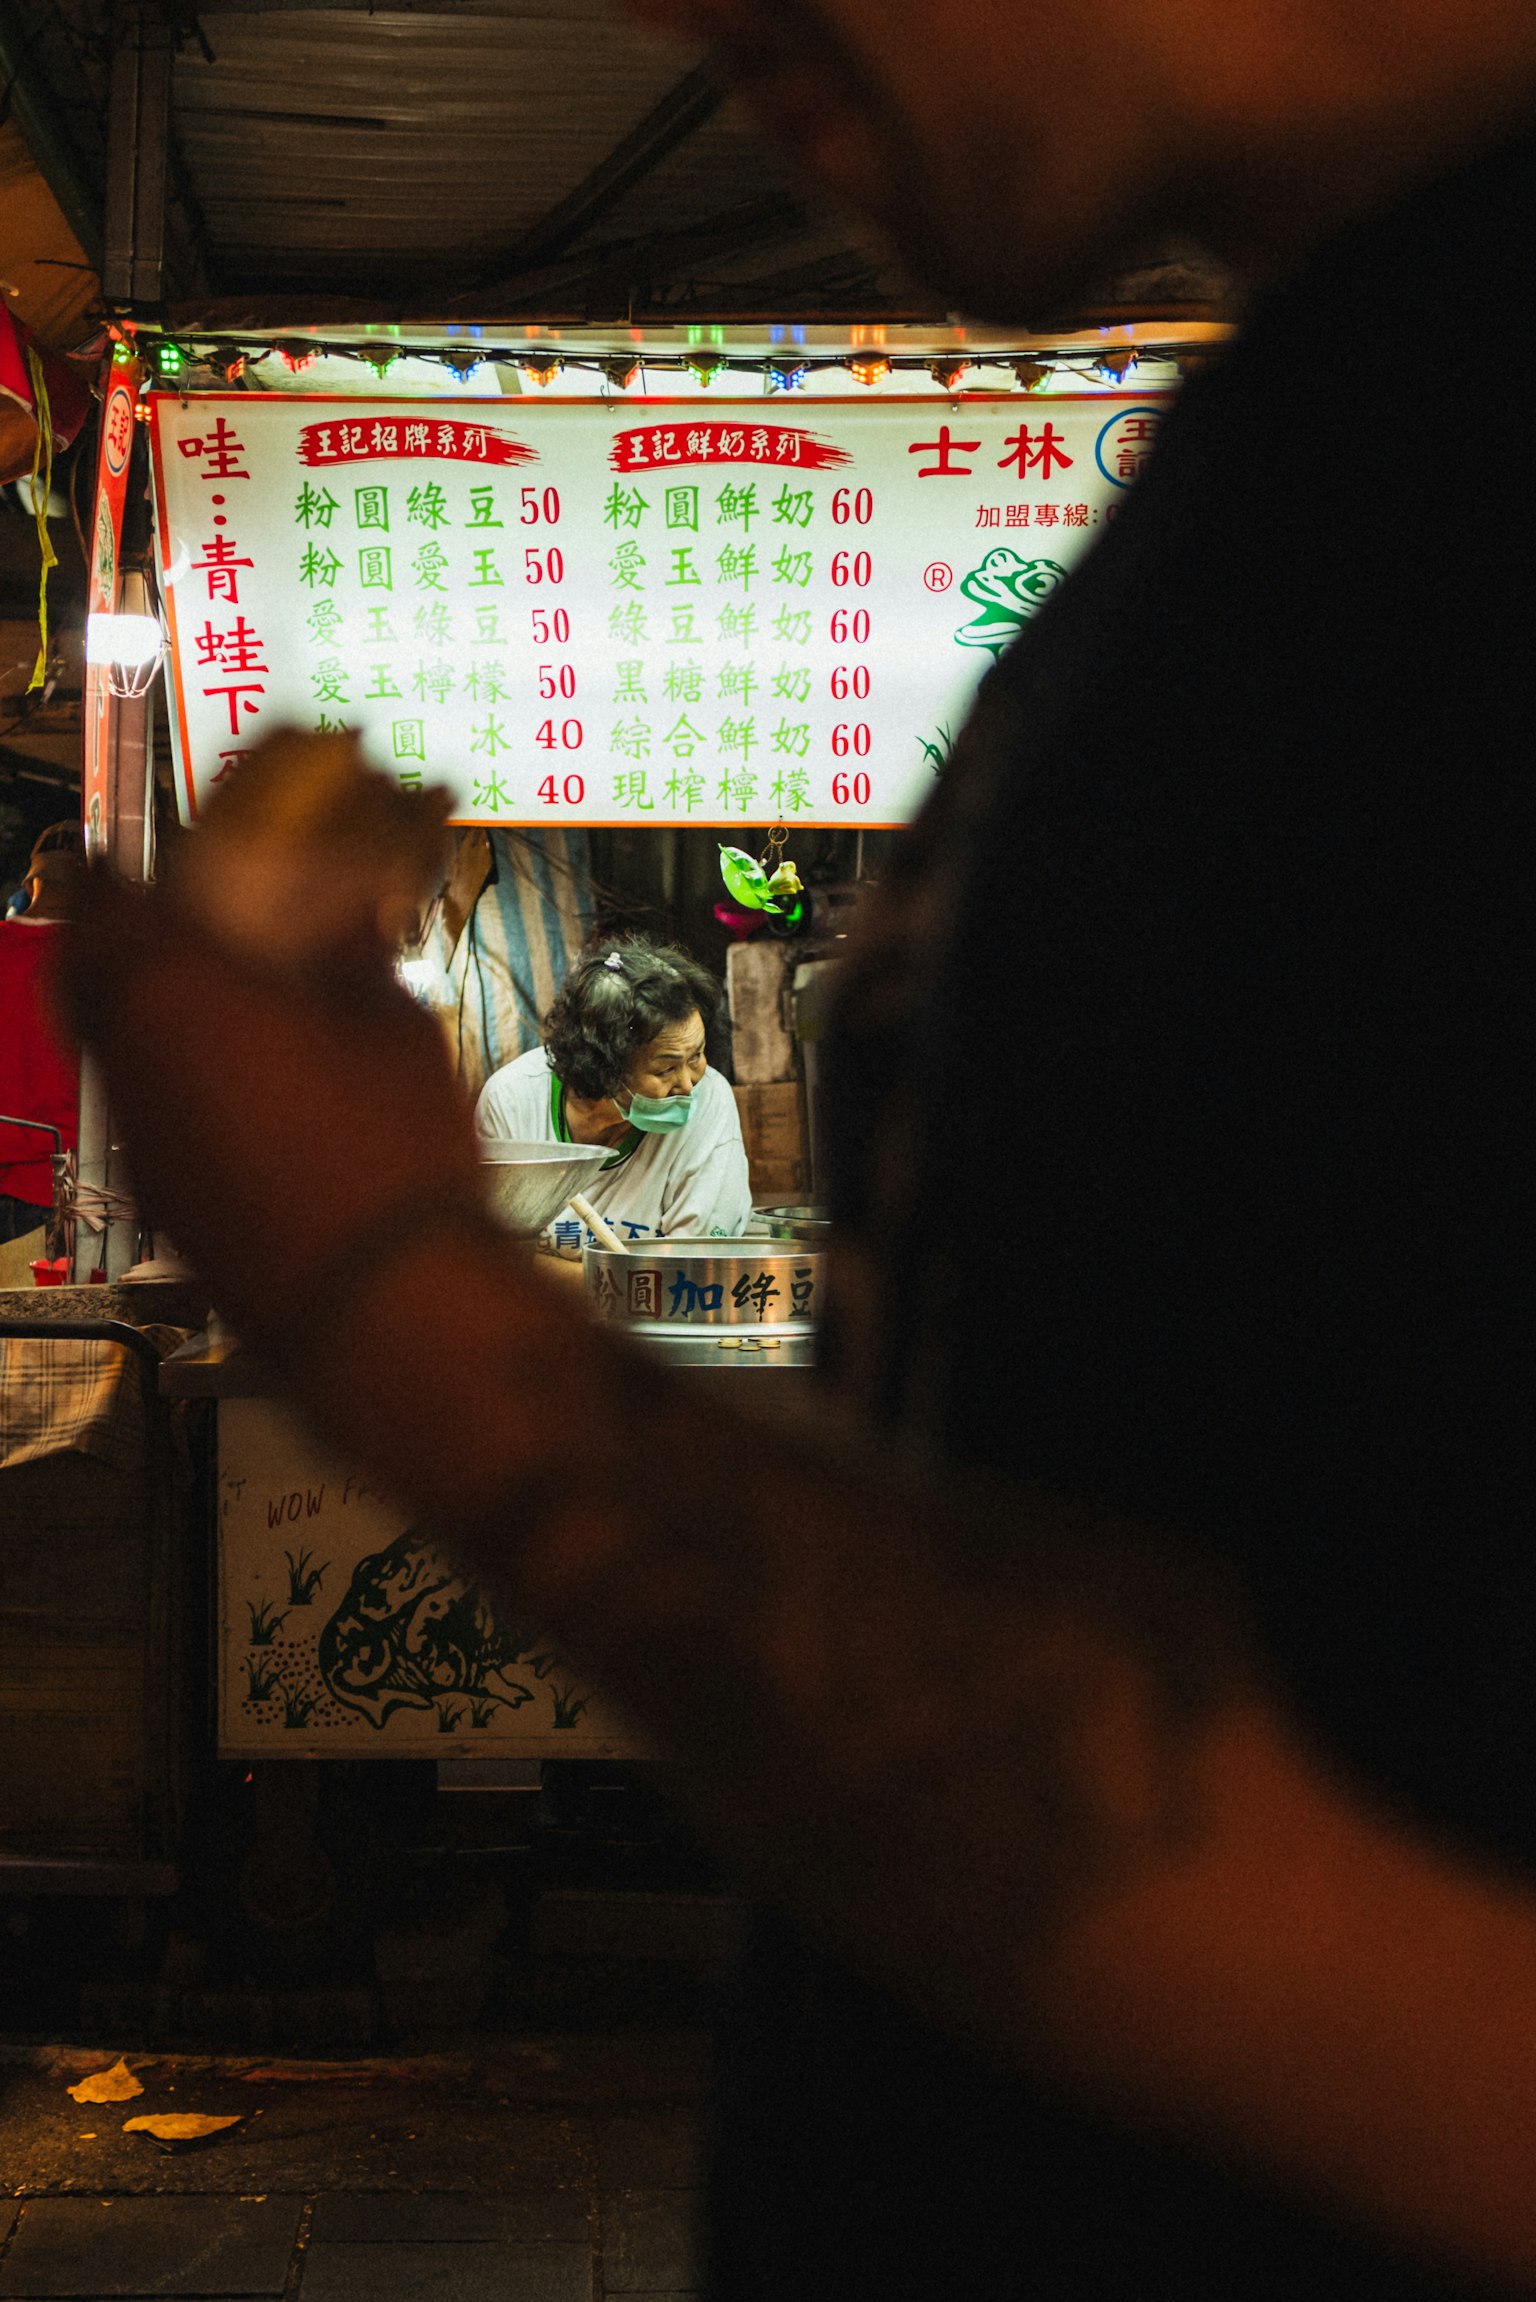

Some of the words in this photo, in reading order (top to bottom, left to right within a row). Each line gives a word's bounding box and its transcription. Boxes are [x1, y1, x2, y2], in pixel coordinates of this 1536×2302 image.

[316, 422, 488, 458] 王記招牌系列
[627, 428, 801, 463] 王記鮮奶系列
[908, 422, 1074, 481] 士林
[294, 480, 505, 533] 粉圓綠豆
[520, 487, 561, 525] 50
[603, 481, 815, 533] 粉圓鮮奶
[831, 487, 873, 525] 60
[299, 541, 506, 592] 粉圓愛玉
[525, 547, 564, 585] 50
[608, 540, 814, 592] 愛玉鮮奶
[830, 550, 873, 588] 60
[306, 598, 509, 647] 愛玉綠豆
[531, 608, 570, 644] 50
[608, 599, 812, 649] 綠豆鮮奶
[830, 608, 871, 645] 60
[310, 656, 512, 705] 愛玉檸檬
[538, 664, 576, 699] 50
[612, 659, 813, 706] 黑糖鮮奶
[830, 665, 871, 701] 60
[535, 719, 584, 750] 40
[609, 712, 813, 761] 綜合鮮奶
[831, 723, 872, 757] 60
[537, 774, 585, 805] 40
[612, 766, 815, 814] 現榨檸檬
[831, 772, 872, 805] 60
[267, 1483, 325, 1529] WOW
